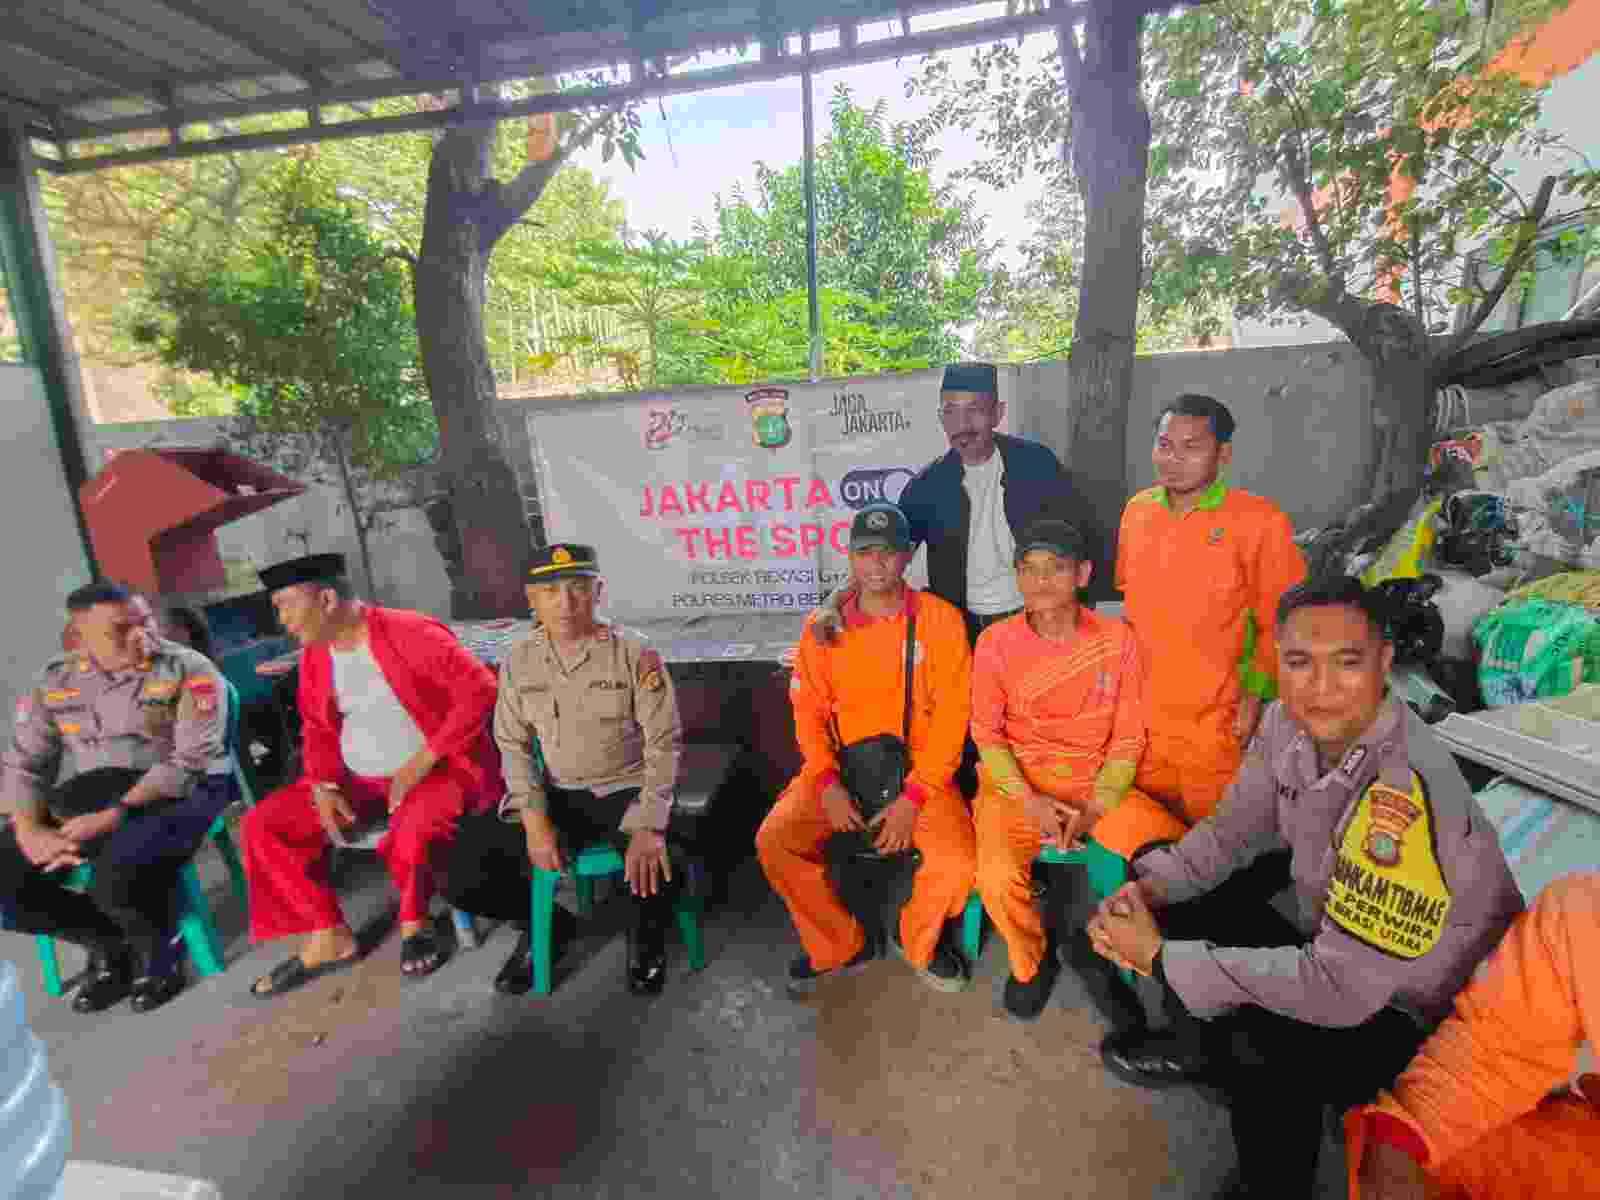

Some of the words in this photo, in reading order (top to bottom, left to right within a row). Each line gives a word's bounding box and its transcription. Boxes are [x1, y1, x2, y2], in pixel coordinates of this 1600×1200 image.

[842, 411, 906, 434] JAKARTA
[640, 476, 833, 519] JAKARTA
[843, 482, 881, 500] ON
[674, 527, 758, 558] THE
[769, 522, 849, 557] SPO
[755, 568, 814, 584] BEKASI
[672, 592, 732, 608] POLRES
[735, 592, 794, 608] METRO
[1344, 893, 1433, 940] PERWIRA
[1379, 927, 1421, 951] UTARA
